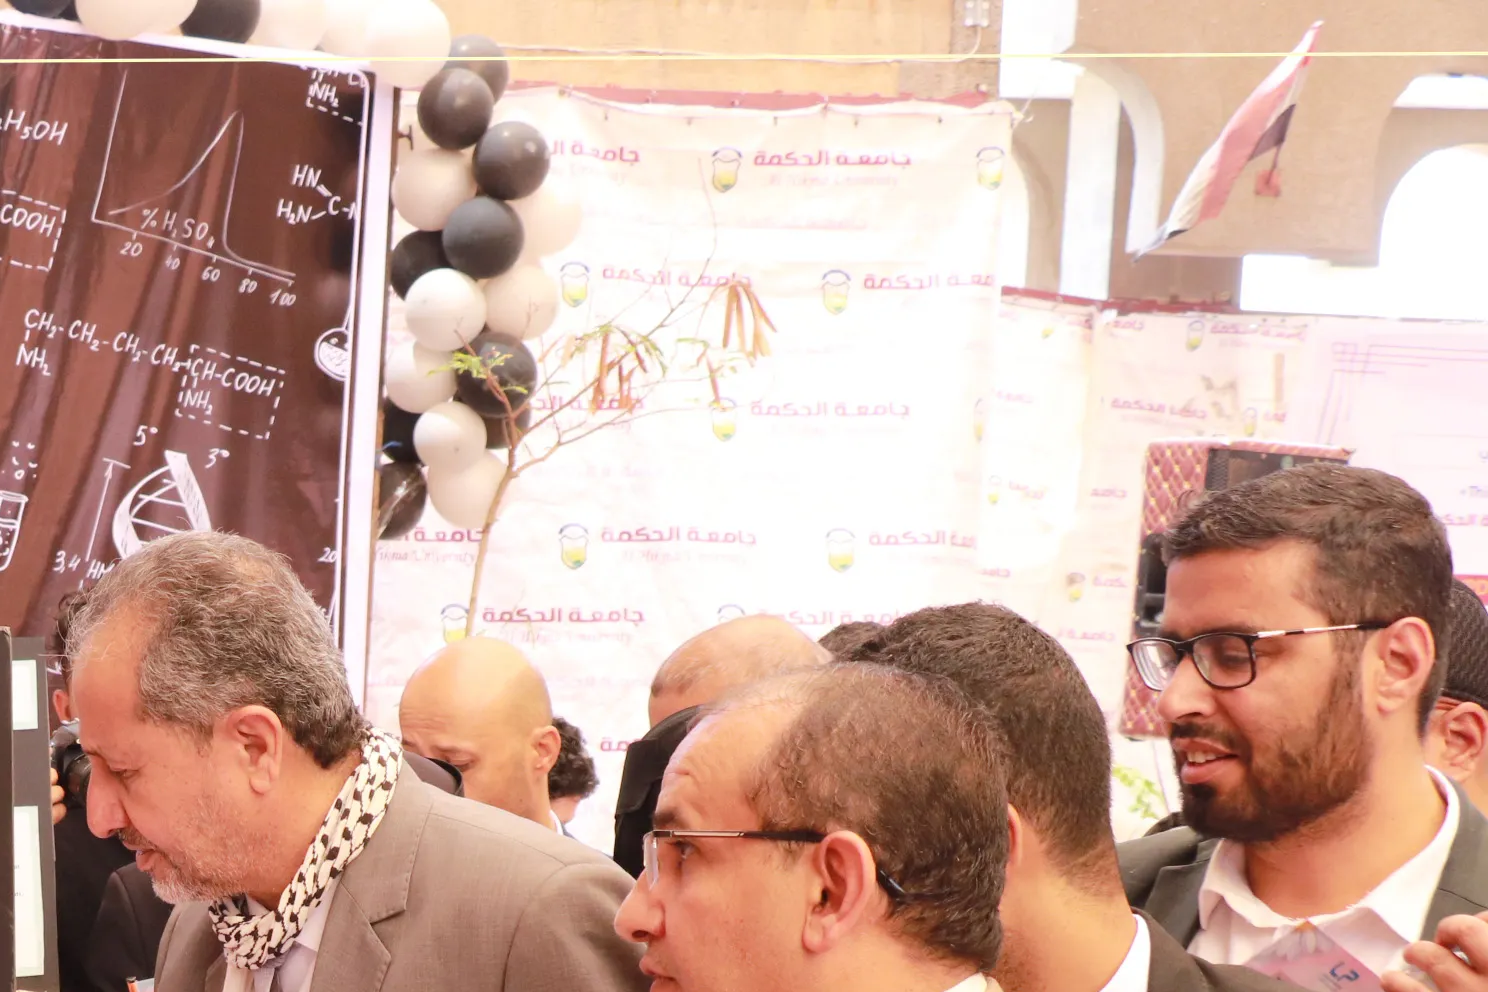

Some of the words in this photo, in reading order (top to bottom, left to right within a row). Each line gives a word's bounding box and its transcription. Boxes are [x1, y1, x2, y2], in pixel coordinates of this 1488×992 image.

[572, 142, 641, 166] جامعة
[753, 148, 830, 167] الحكمة
[836, 150, 912, 170] جامعة
[119, 240, 144, 257] 20
[201, 266, 222, 283] 60
[238, 278, 259, 294] 80
[270, 287, 298, 307] 100
[750, 399, 828, 418] الحكمة
[834, 400, 910, 420] جامعة
[601, 526, 680, 544] الحكمة
[687, 527, 758, 548] جامعة
[868, 529, 946, 548] الحكمة
[482, 605, 562, 624] الحكمة
[568, 606, 647, 627] جامعة
